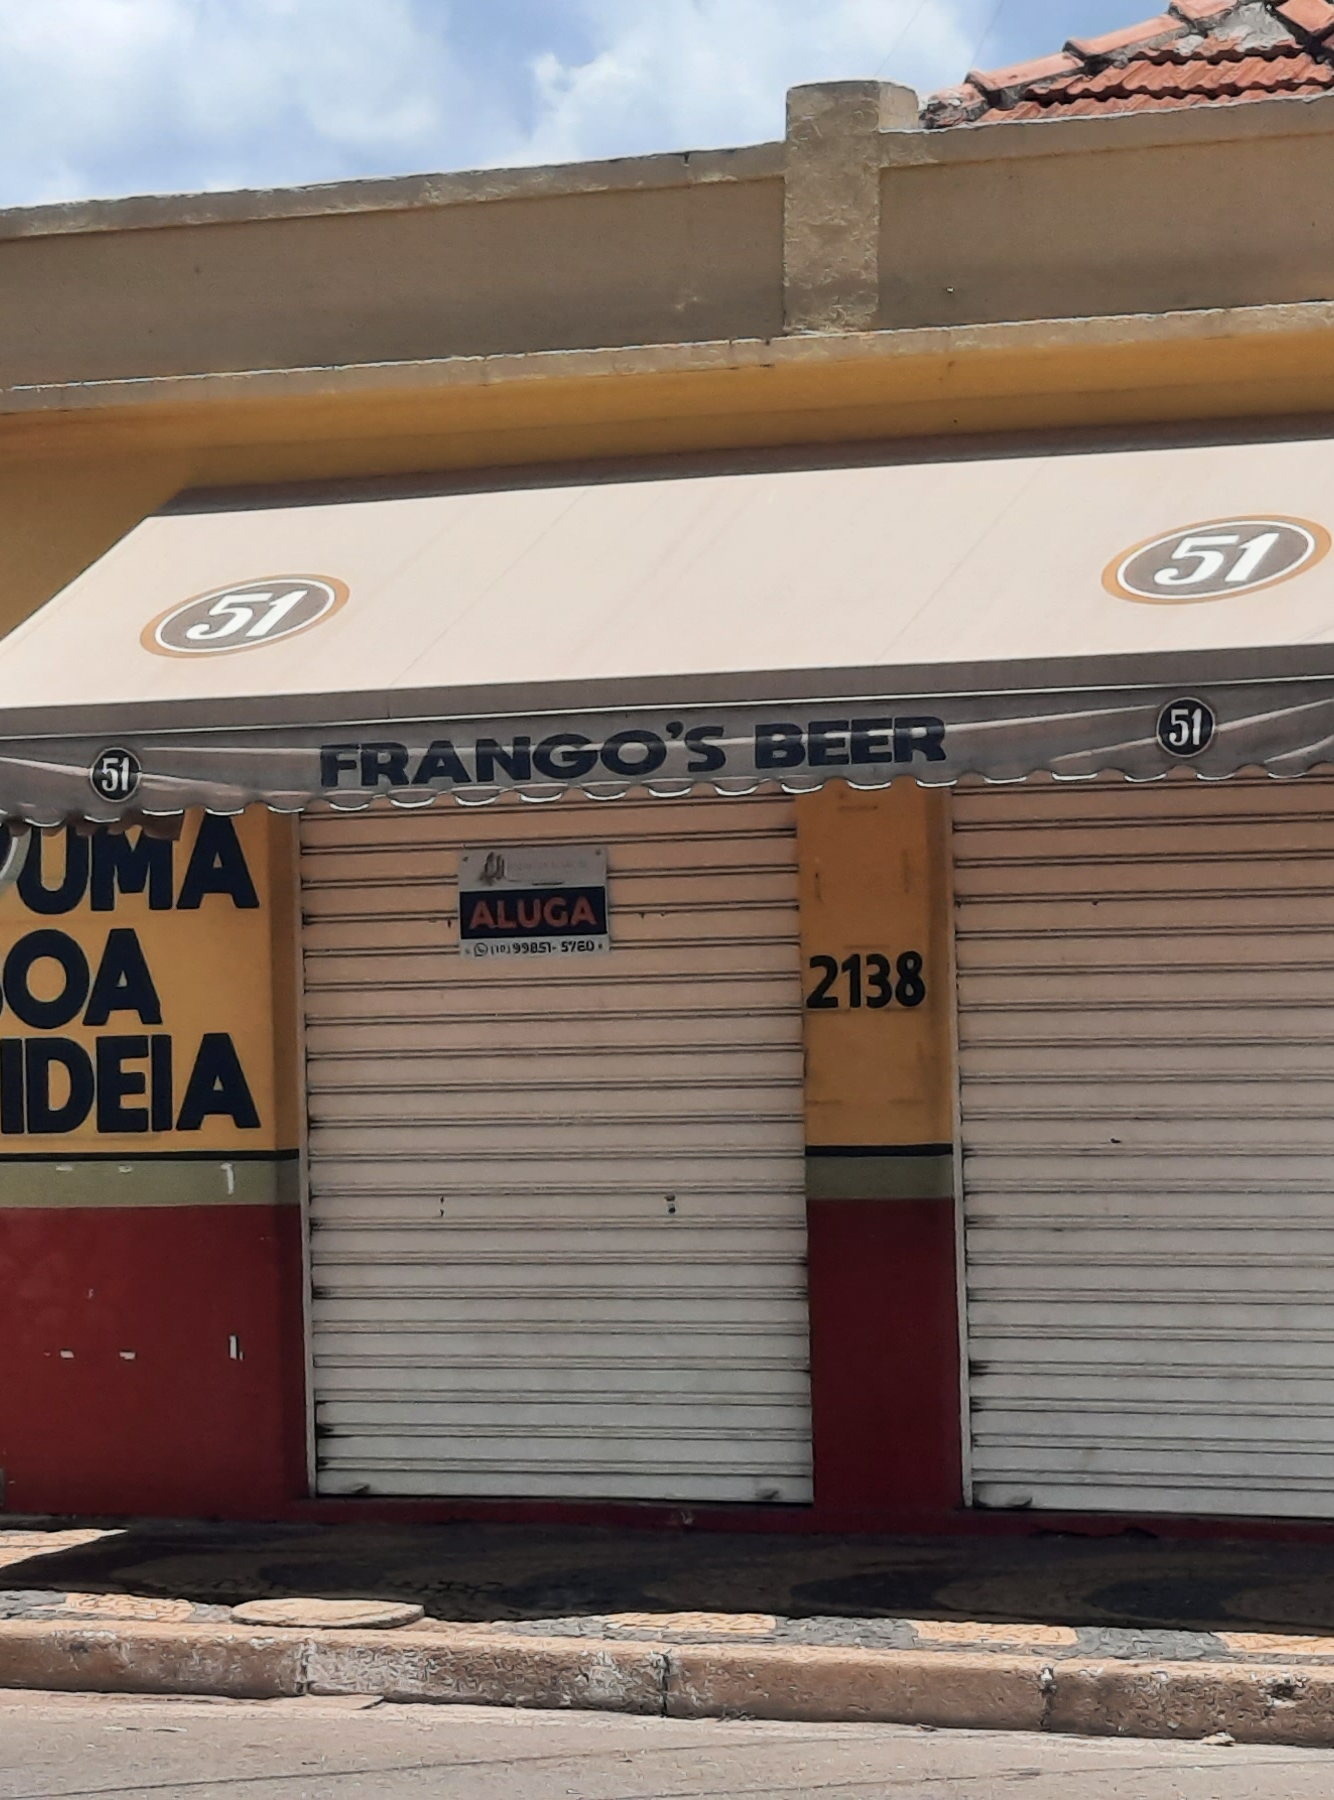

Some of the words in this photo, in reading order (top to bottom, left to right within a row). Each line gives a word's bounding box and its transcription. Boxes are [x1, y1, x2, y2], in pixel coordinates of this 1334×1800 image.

[1153, 531, 1281, 587] 51
[185, 589, 309, 641] 51
[319, 720, 727, 788] FRANGO'S
[754, 715, 947, 770] BEER
[1167, 707, 1203, 748] 51
[98, 756, 131, 793] 51
[17, 810, 261, 915] UMA
[469, 895, 598, 930] ALUGA
[805, 950, 926, 1009] 2138
